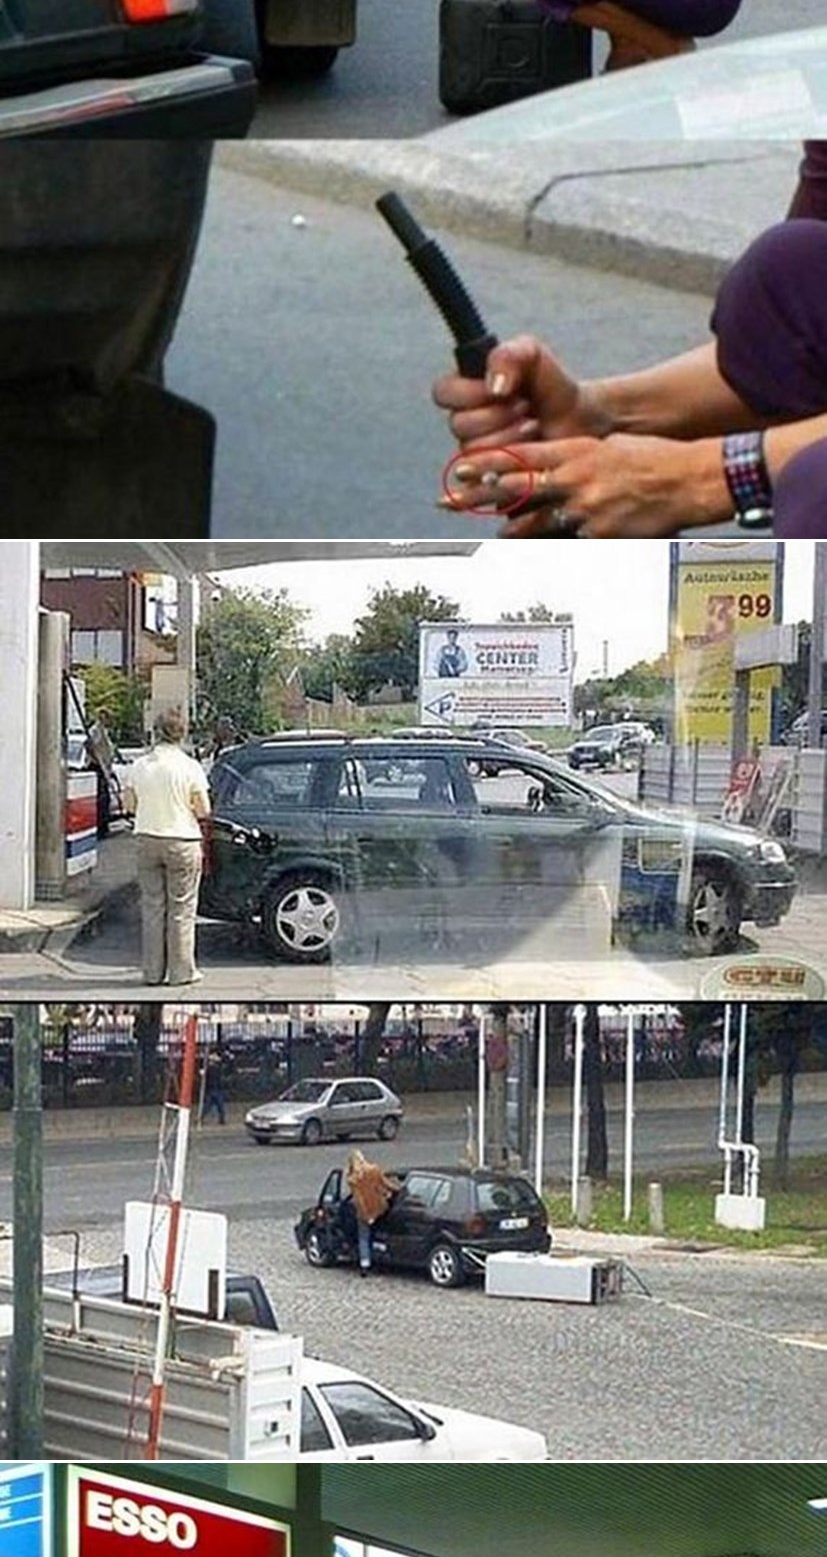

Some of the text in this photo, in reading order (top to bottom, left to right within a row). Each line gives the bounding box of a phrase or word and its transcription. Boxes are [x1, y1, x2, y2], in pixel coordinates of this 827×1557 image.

[738, 594, 771, 618] 99
[475, 652, 539, 666] CENTER
[86, 1489, 198, 1550] ESSO
